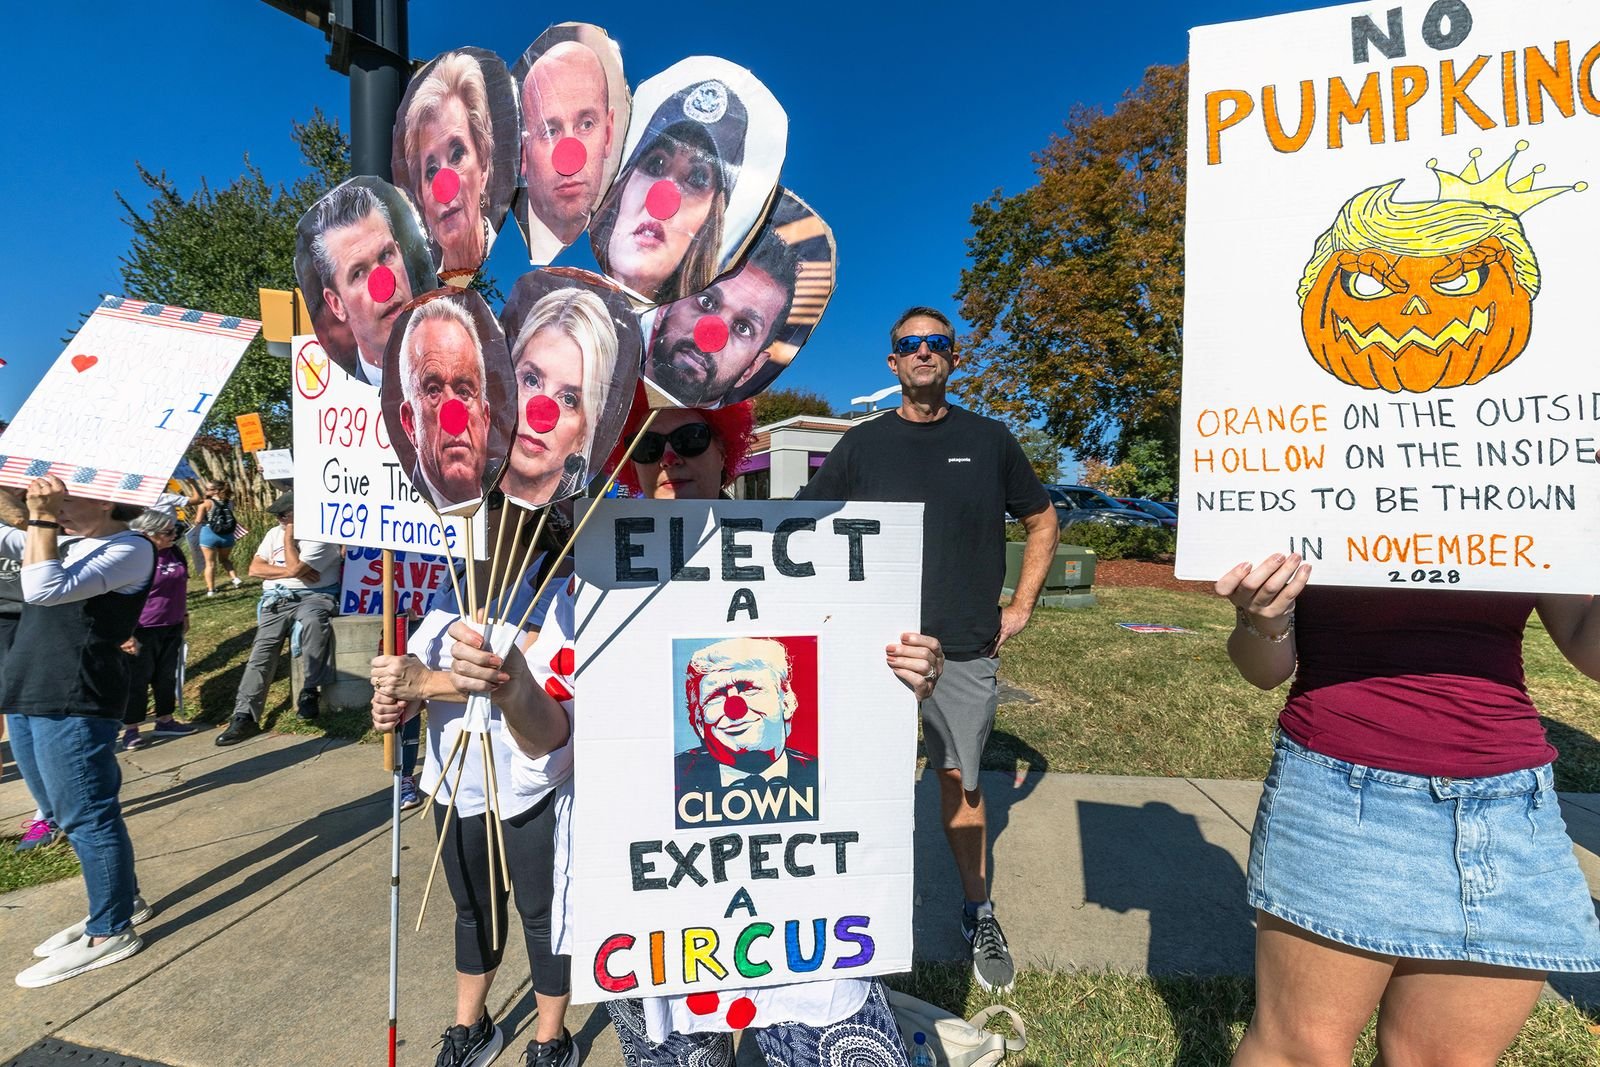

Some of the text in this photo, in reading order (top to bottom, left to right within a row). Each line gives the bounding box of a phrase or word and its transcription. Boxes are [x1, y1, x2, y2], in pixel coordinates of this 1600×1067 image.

[1351, 0, 1474, 64] NO
[318, 406, 368, 448] 1939
[1197, 404, 1327, 437] ORANGE
[1343, 403, 1380, 430] ON
[1388, 398, 1456, 428] THE
[1194, 437, 1597, 472] HOLLOW ON THE INSIDE
[322, 457, 426, 503] Give The
[1196, 484, 1577, 513] NEEDS TO BE THROWN
[320, 502, 457, 549] 1789 France
[614, 516, 881, 583] ELECT
[1289, 533, 1551, 568] IN NOVEMBER.
[360, 559, 446, 590] SAVE
[1388, 569, 1461, 584] 2028
[726, 587, 760, 623] A
[677, 785, 815, 824] CLOWN
[629, 831, 860, 892] EXPECT
[724, 886, 758, 919] A
[594, 915, 876, 992] CIRCUS
